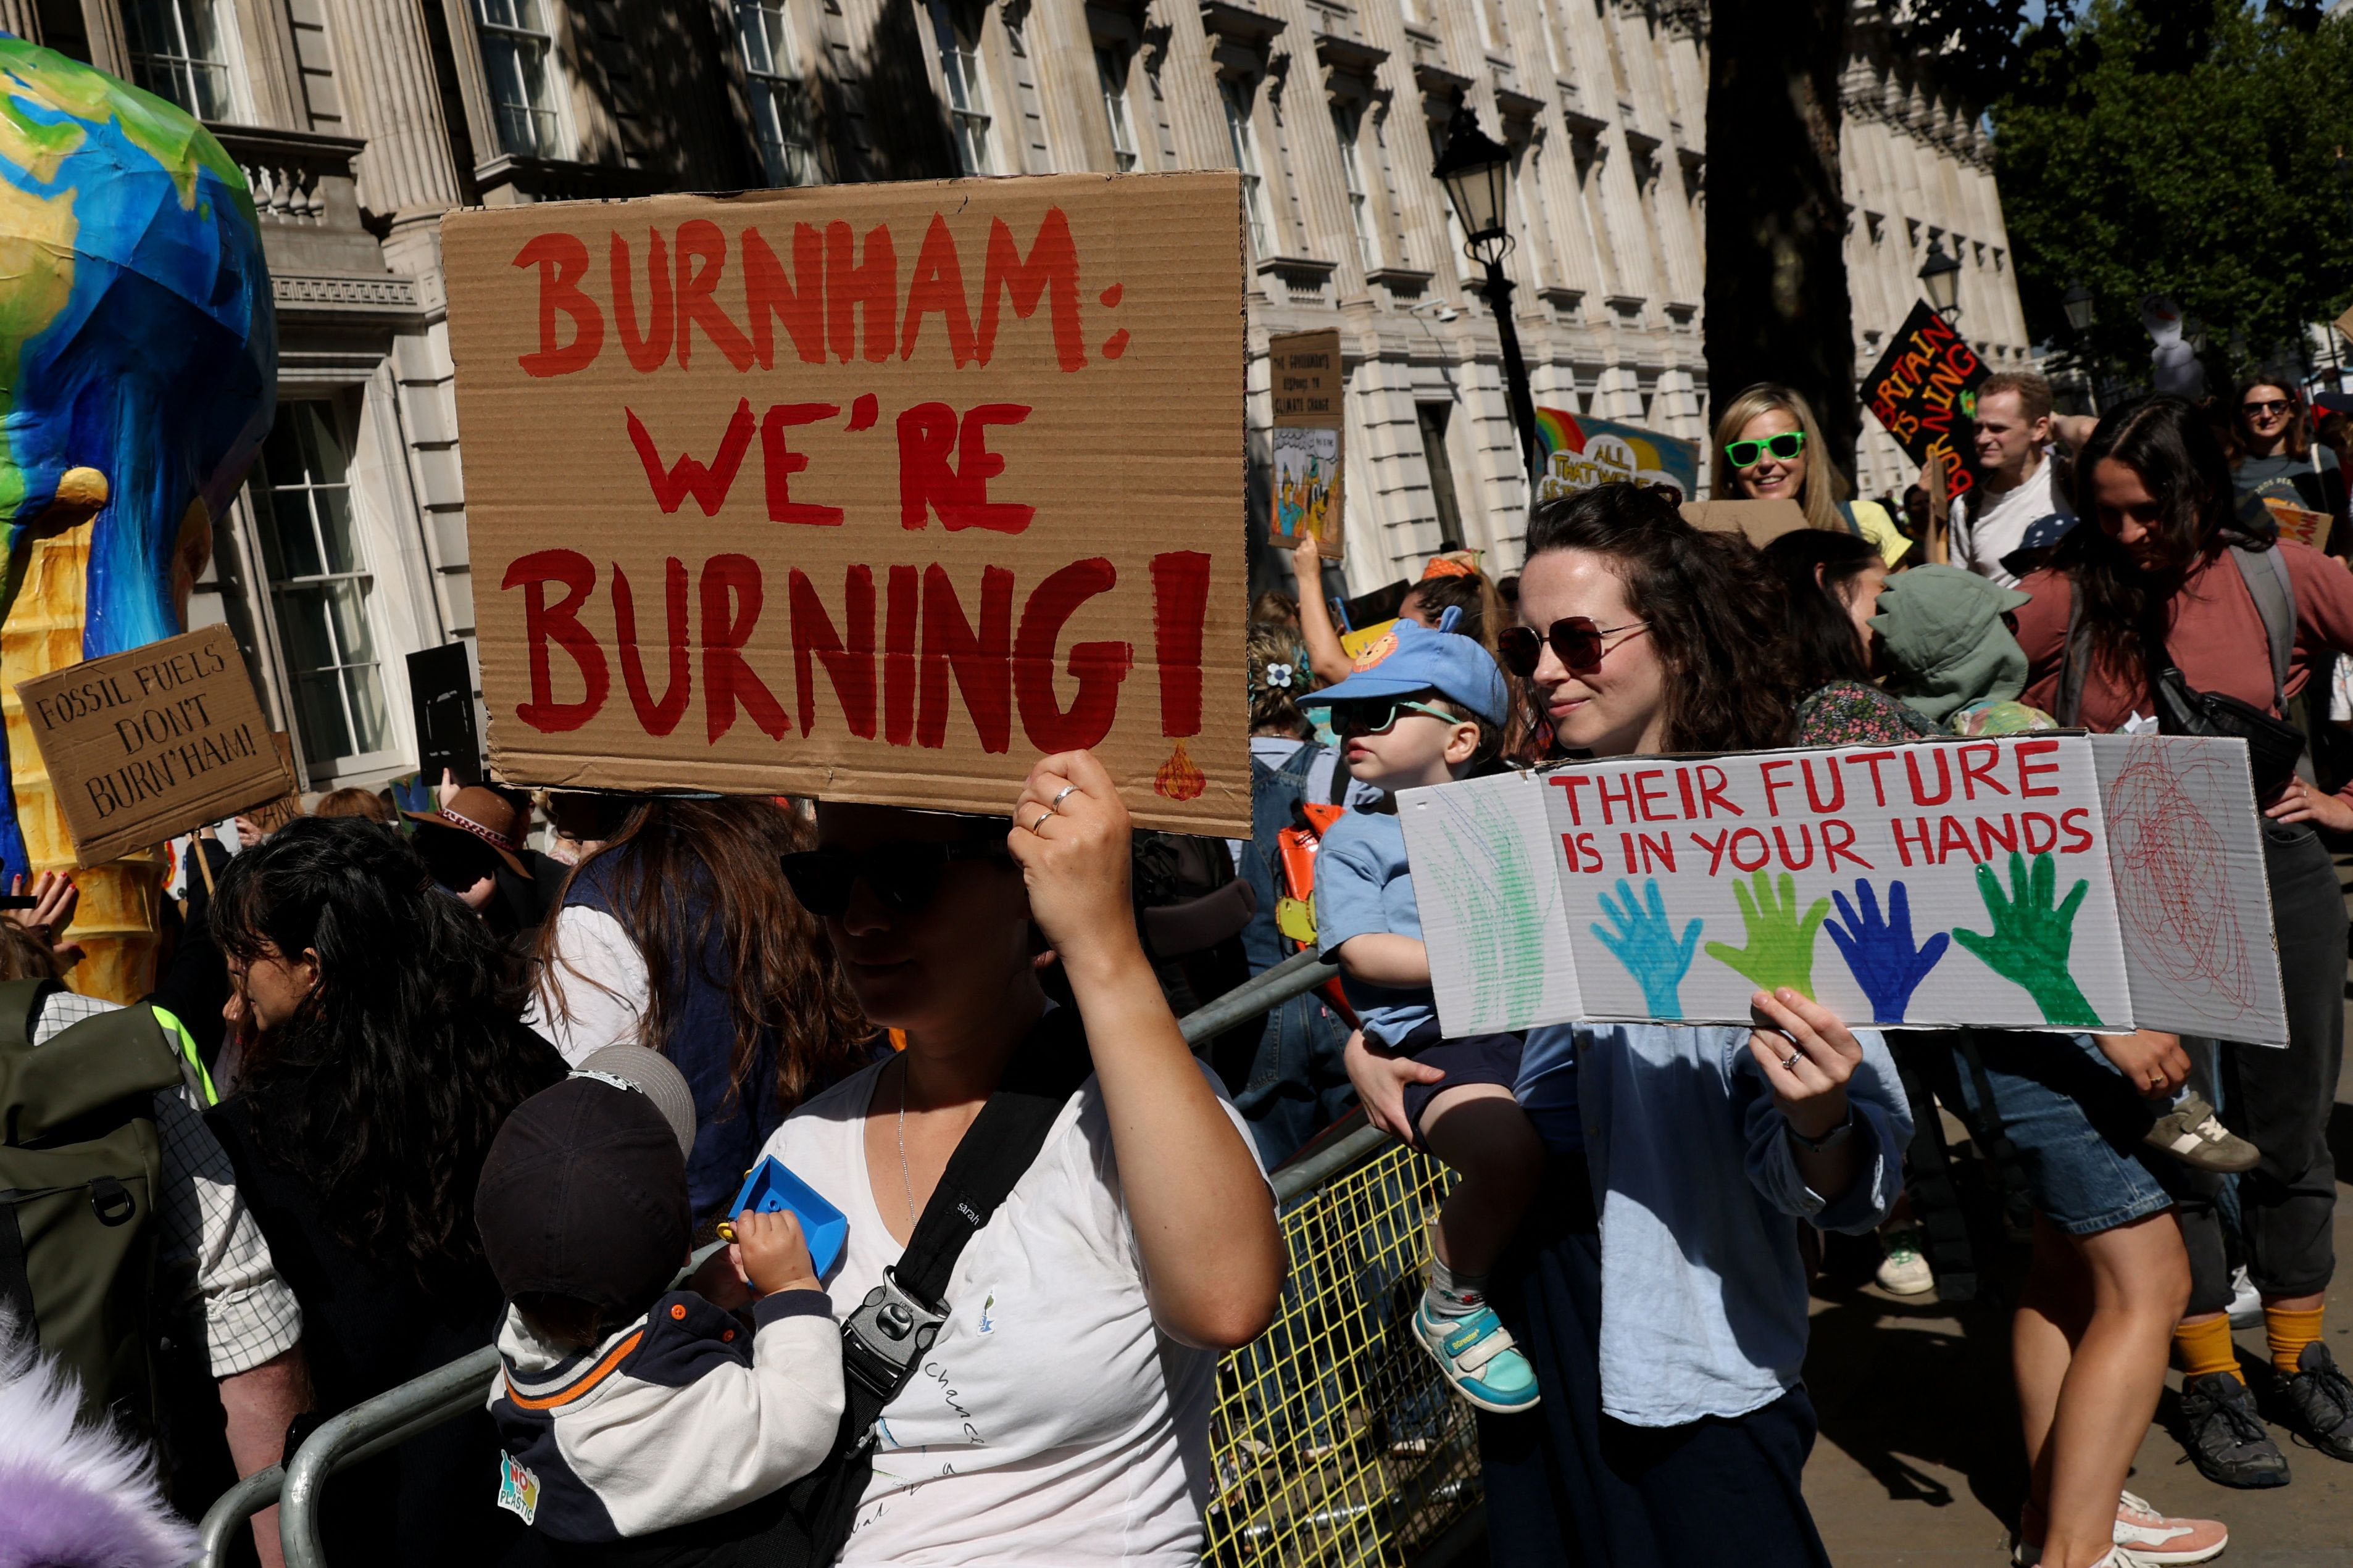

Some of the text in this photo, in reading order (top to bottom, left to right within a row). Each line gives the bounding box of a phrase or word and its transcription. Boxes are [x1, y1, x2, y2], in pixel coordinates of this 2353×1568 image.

[510, 205, 1130, 378] BURNHAM:
[1872, 315, 1955, 431] BRITAIN
[1594, 444, 1631, 471] ALL
[1892, 410, 1919, 444] IS
[623, 392, 1036, 536] WE'RE
[1552, 454, 1597, 484] THAT
[501, 549, 1213, 756] BURNING!
[36, 642, 225, 731] FOSSIL FUELS
[114, 693, 211, 756] DON'T
[85, 723, 257, 819] BURN'HAM!
[1549, 740, 2060, 826] THEIR FUTURE
[1560, 807, 2094, 877] IS IN YOUR HANDS
[957, 1202, 980, 1226] sarah
[500, 1490, 533, 1521] PLASTIC
[510, 1463, 528, 1491] NO
[516, 1484, 522, 1495] to
